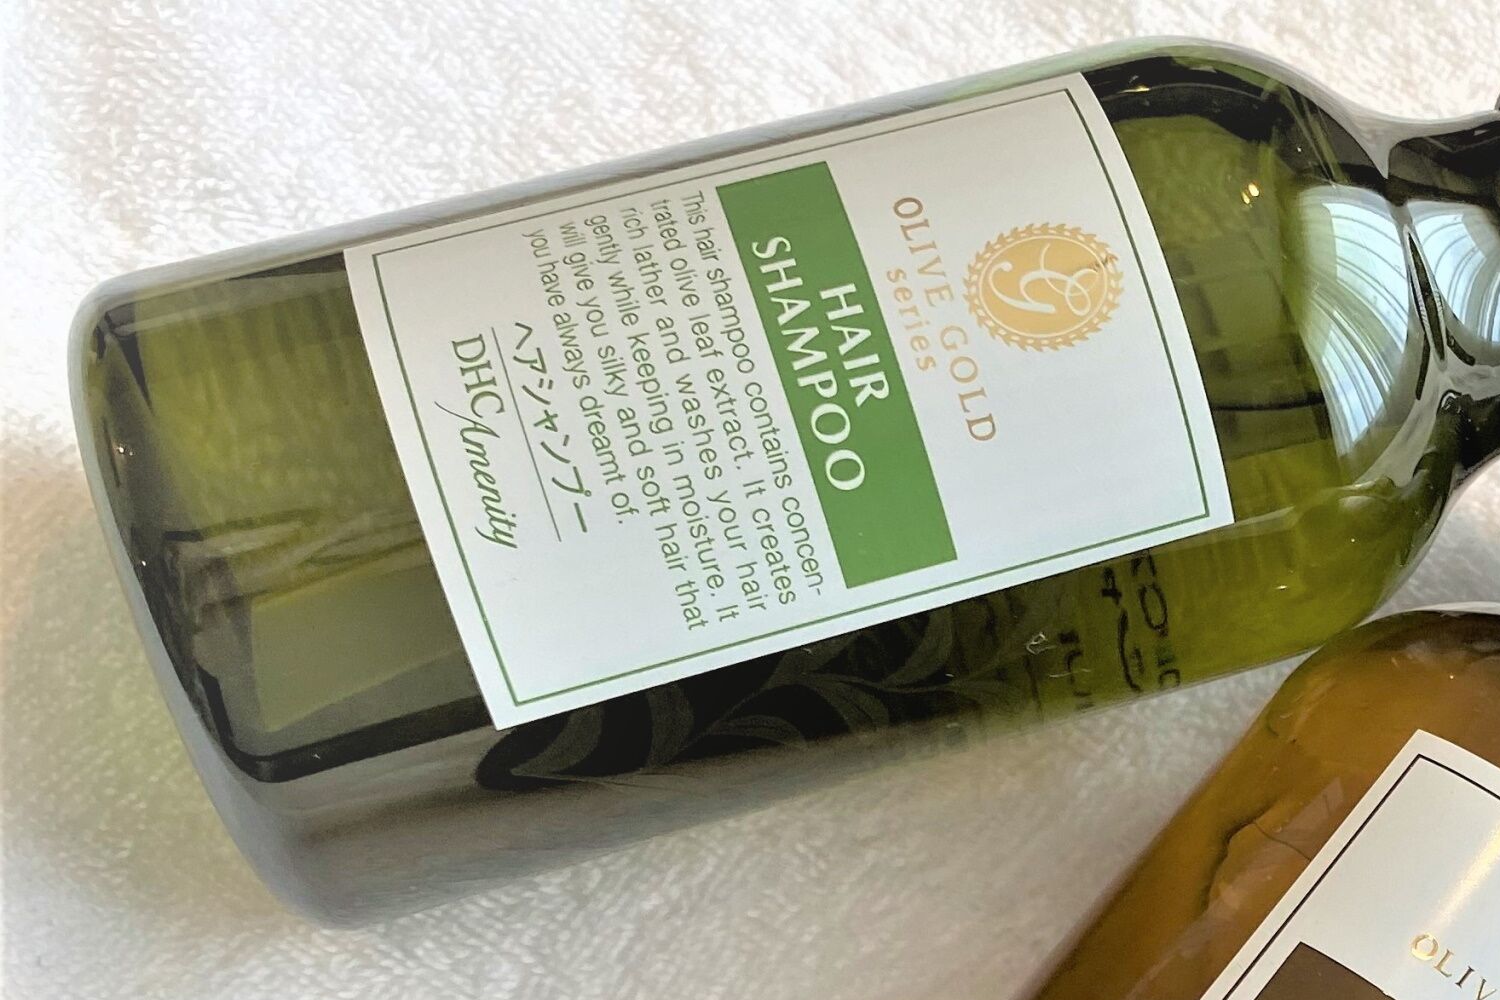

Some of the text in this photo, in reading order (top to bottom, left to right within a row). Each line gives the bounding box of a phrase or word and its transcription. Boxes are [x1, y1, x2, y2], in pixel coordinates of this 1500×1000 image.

[434, 333, 517, 548] DHC Amenity
[512, 322, 592, 532] ヘアシャンプー
[522, 229, 639, 524] you have always dreamt of.
[558, 221, 708, 630] will give you silky and soft hair that
[584, 214, 739, 622] gently while keeping in moisture. It
[619, 206, 768, 610] rich lather and washes your hair
[650, 198, 796, 605] trated olive leaf extract. It creates
[680, 190, 823, 595] This hair shampoo contains concen-
[751, 236, 865, 490] SHAMPOO
[818, 282, 889, 407] HAIR
[886, 267, 937, 371] series
[892, 196, 996, 441] OLIVE GOLD
